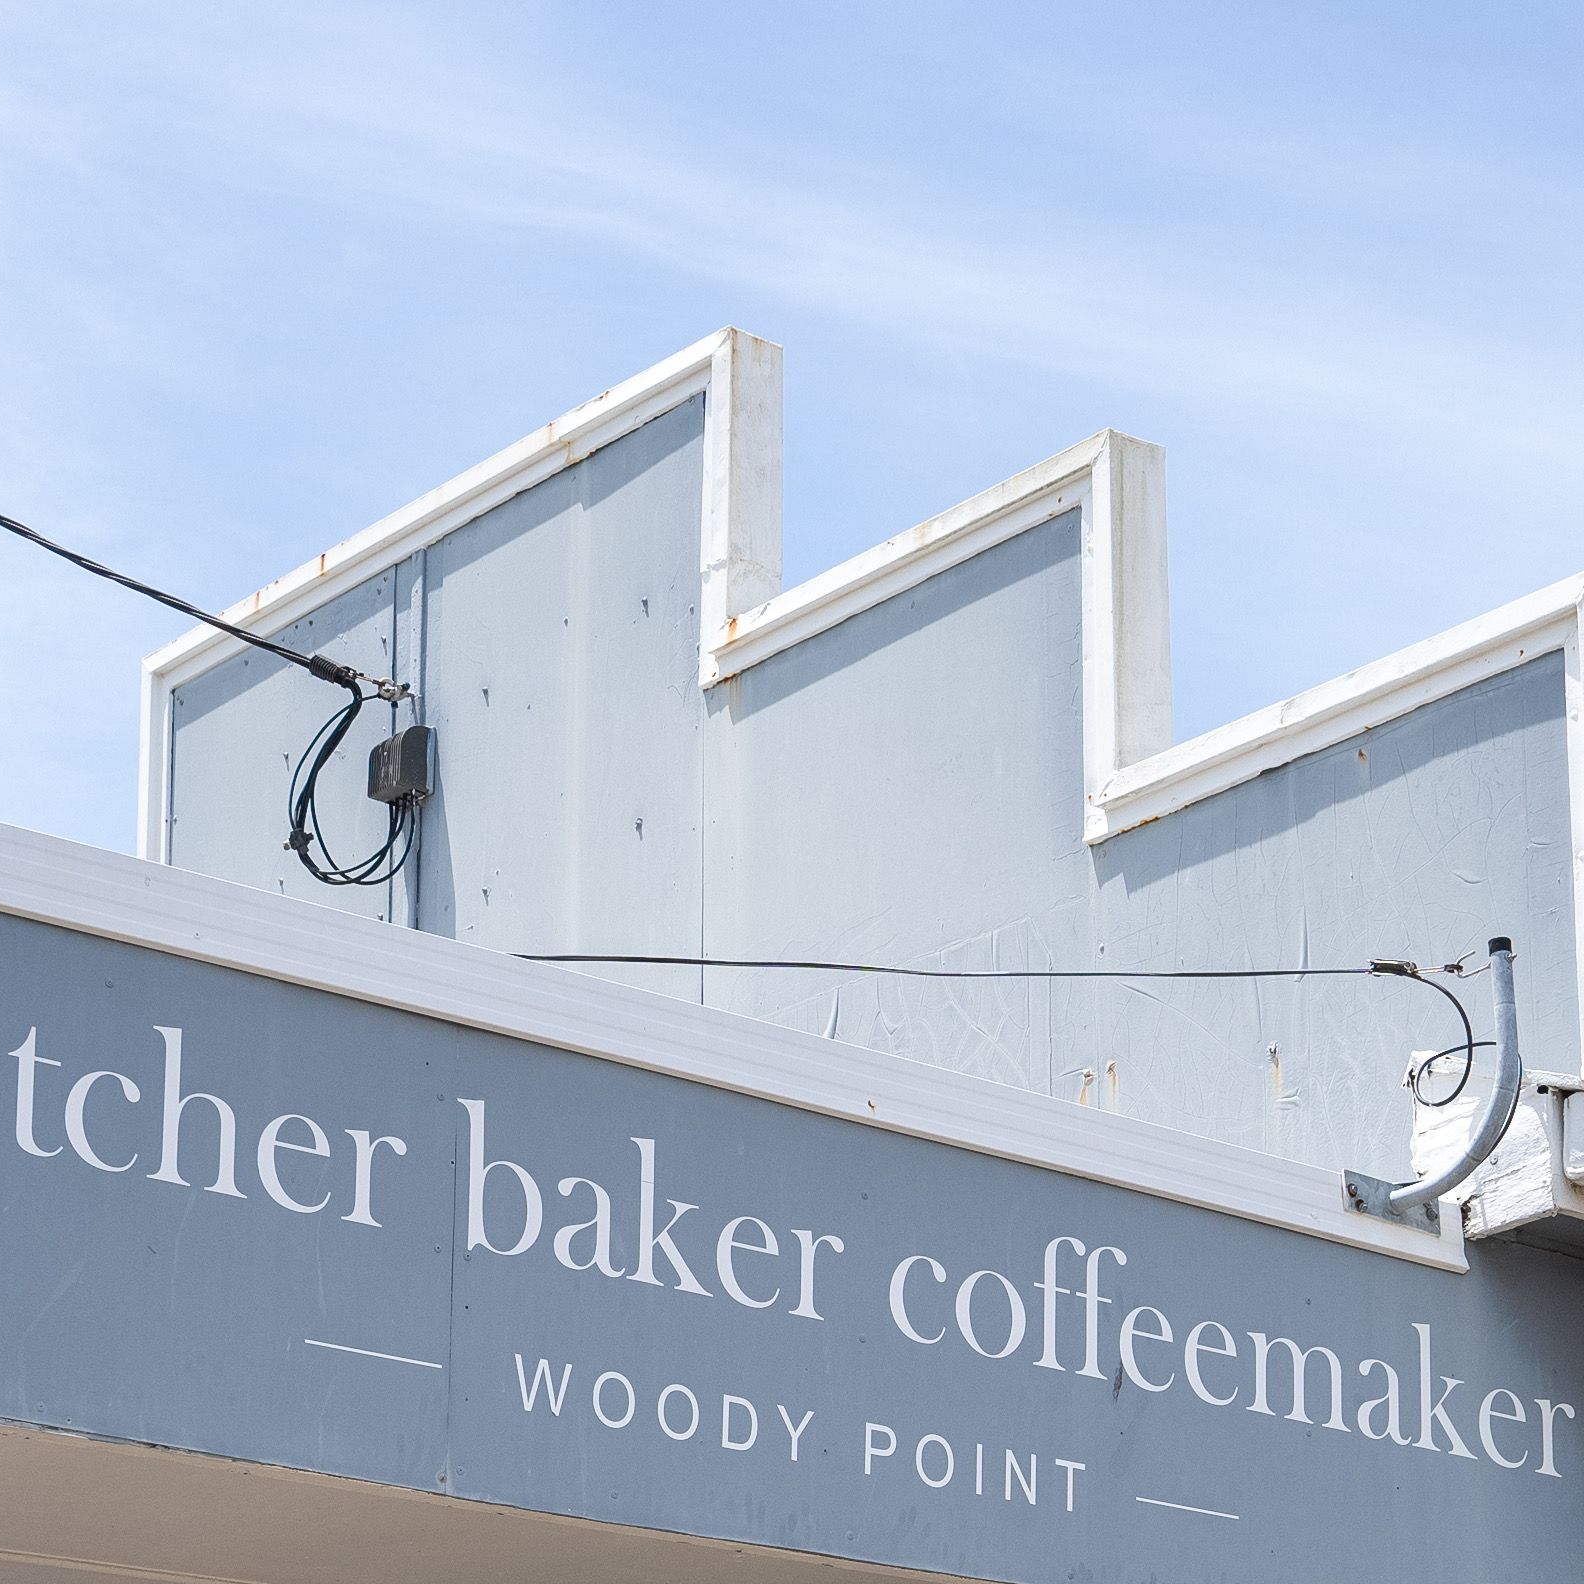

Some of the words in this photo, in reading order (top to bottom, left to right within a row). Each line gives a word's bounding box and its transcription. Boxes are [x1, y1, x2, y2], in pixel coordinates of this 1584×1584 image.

[456, 1098, 845, 1320] baker
[889, 1236, 1576, 1478] coffeemaker
[515, 1354, 814, 1462] WOODY
[865, 1422, 1086, 1512] POINT
